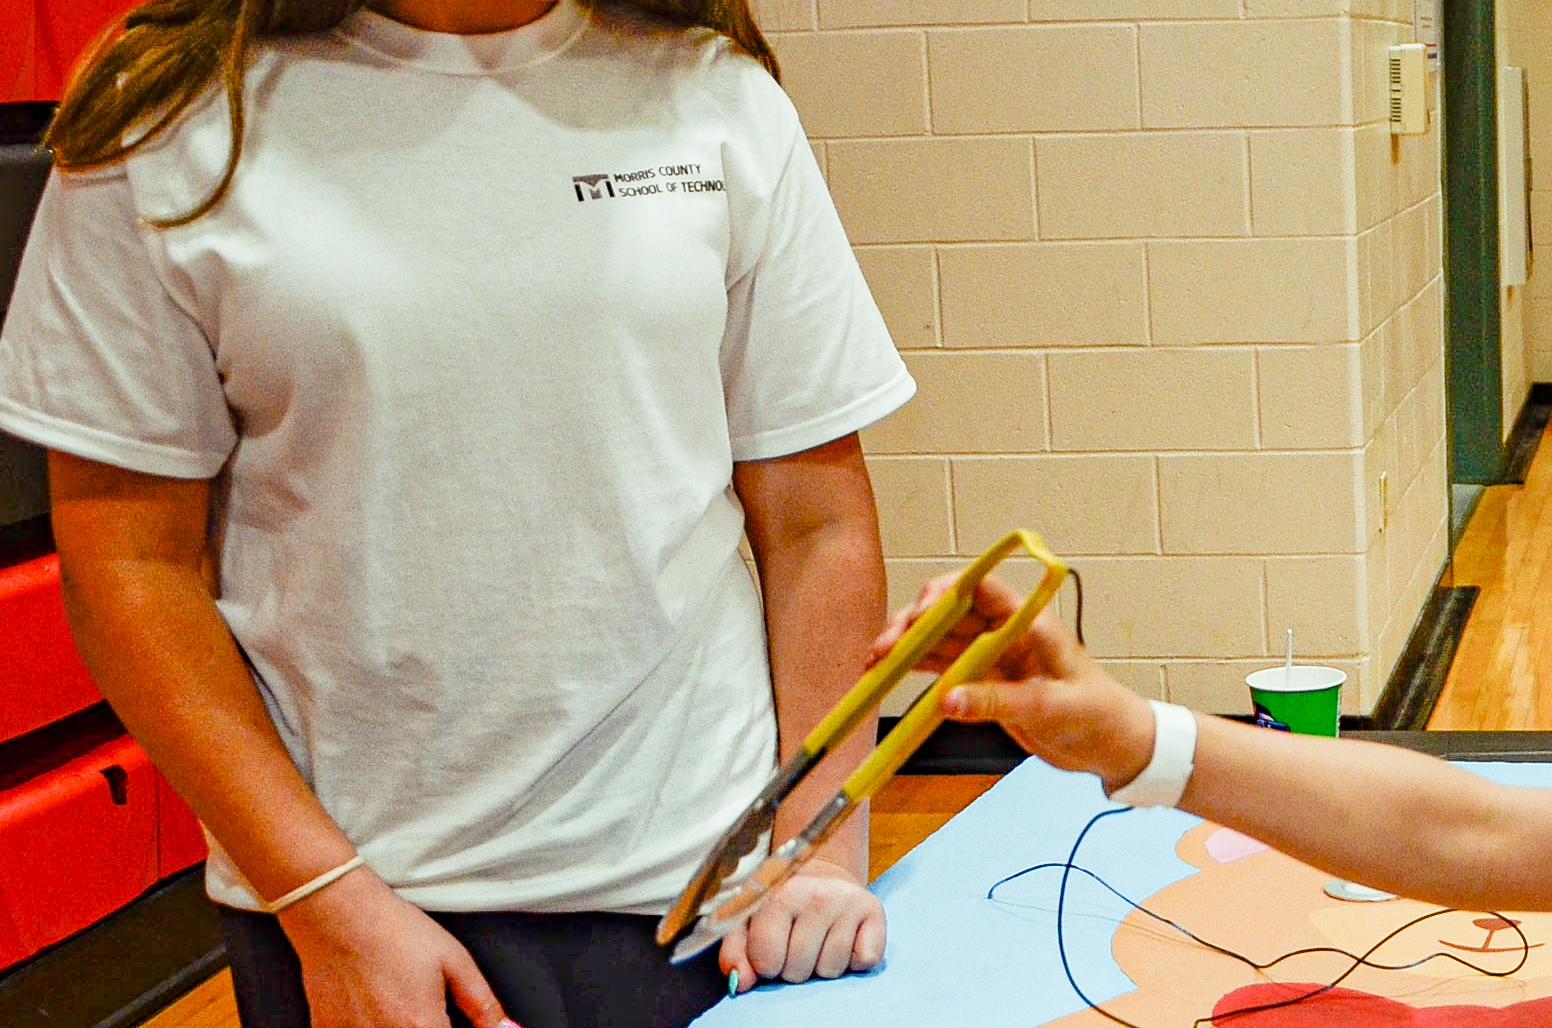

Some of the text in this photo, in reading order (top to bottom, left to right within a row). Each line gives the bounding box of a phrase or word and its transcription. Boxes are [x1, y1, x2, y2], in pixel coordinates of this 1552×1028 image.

[614, 164, 701, 182] MORRIS COUNTY
[618, 184, 663, 197] SCHOOL
[666, 182, 679, 192] OF
